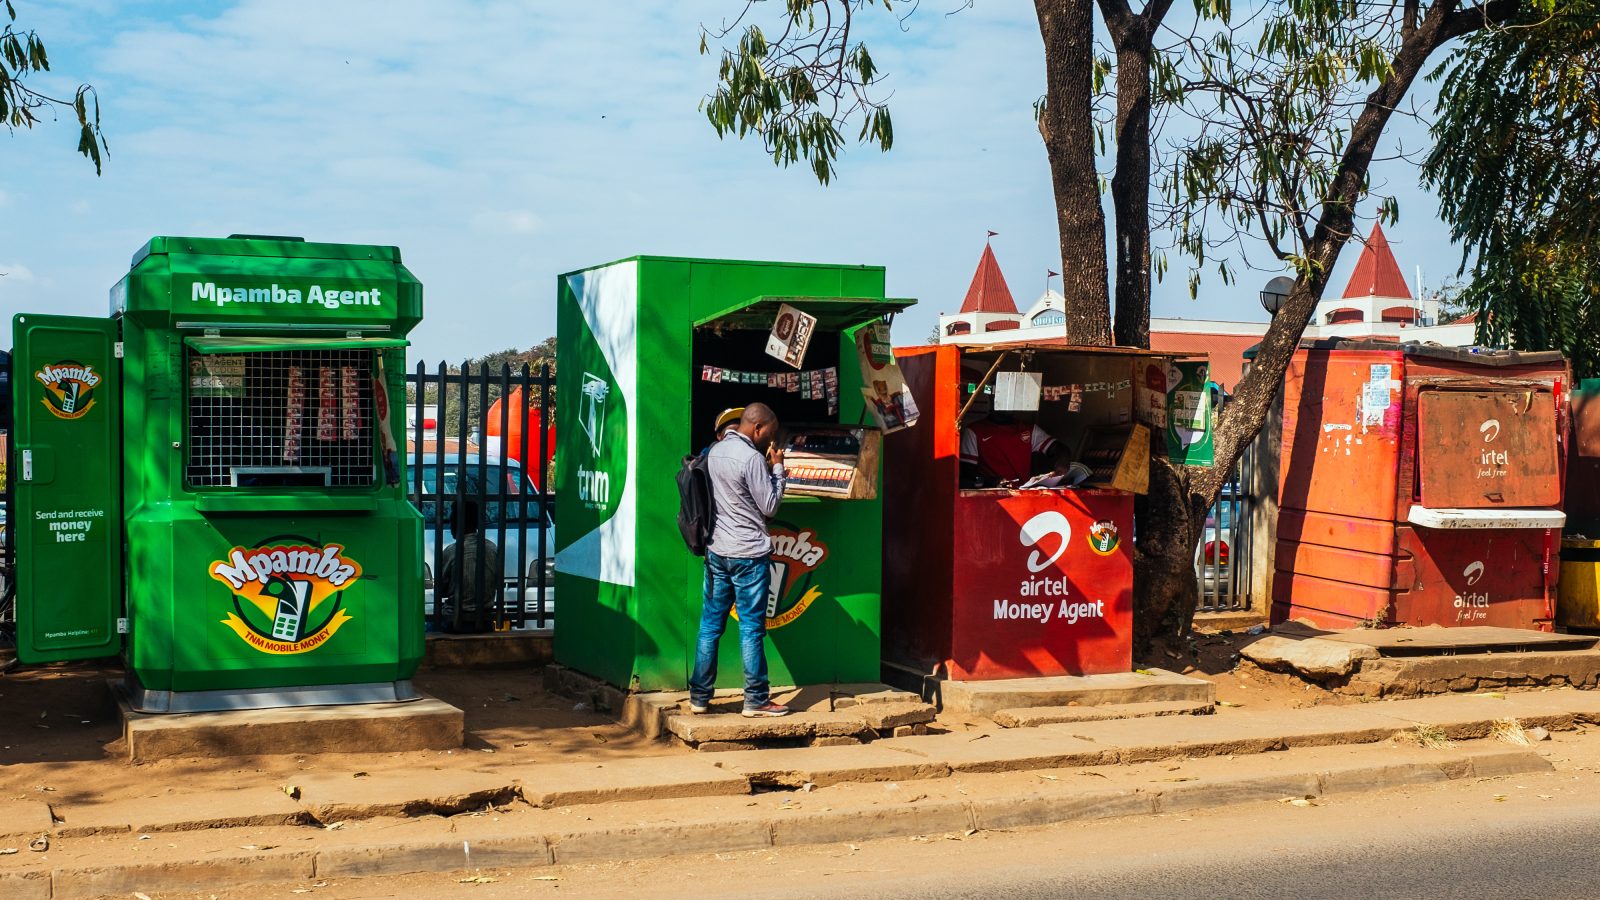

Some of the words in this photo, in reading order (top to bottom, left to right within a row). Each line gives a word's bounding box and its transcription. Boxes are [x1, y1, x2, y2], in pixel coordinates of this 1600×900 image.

[191, 282, 302, 307] Mpamba
[306, 285, 381, 309] Agent
[37, 366, 99, 387] Mpamba
[577, 463, 609, 503] tnm
[1476, 467, 1491, 479] feel
[1491, 467, 1507, 479] free
[35, 510, 57, 520] Send
[57, 509, 74, 518] and
[74, 508, 104, 518] receive
[49, 520, 92, 532] money
[1089, 520, 1118, 535] Mpamba
[56, 531, 85, 543] here
[770, 531, 824, 567] mba
[214, 547, 356, 589] Mpamba
[1020, 575, 1069, 597] airtel
[1453, 591, 1490, 608] airtel
[781, 599, 807, 623] MONEY
[993, 599, 1055, 624] Money
[1057, 599, 1105, 625] Agent
[1470, 610, 1487, 622] free
[244, 631, 264, 647] TNM
[264, 641, 300, 652] MOBILE
[300, 628, 331, 650] MONEY
